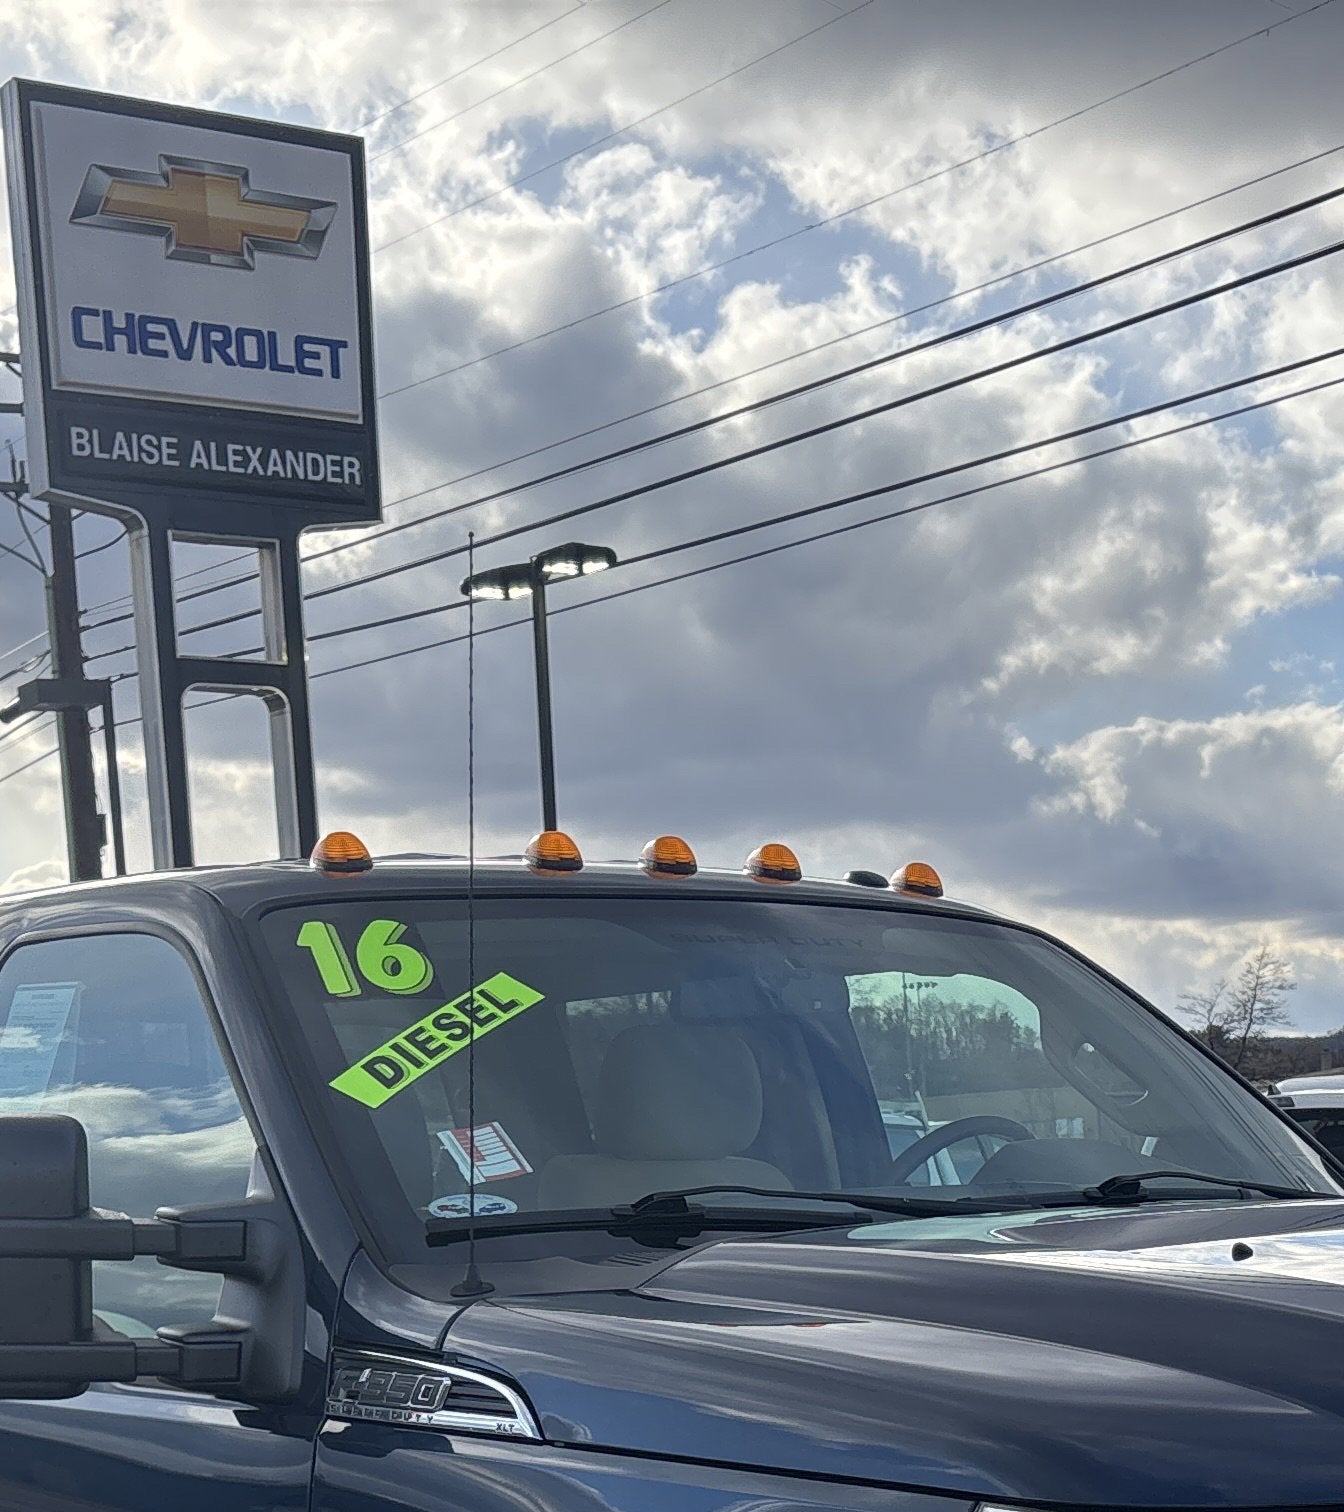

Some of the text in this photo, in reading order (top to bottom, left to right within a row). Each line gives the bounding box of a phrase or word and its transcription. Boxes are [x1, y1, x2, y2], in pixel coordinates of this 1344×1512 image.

[71, 305, 348, 379] CHEVROLET
[69, 426, 362, 485] BLAISE ALEXANDER
[296, 919, 434, 997] 16
[360, 988, 524, 1090] DIESEL
[495, 1422, 516, 1435] XLT
